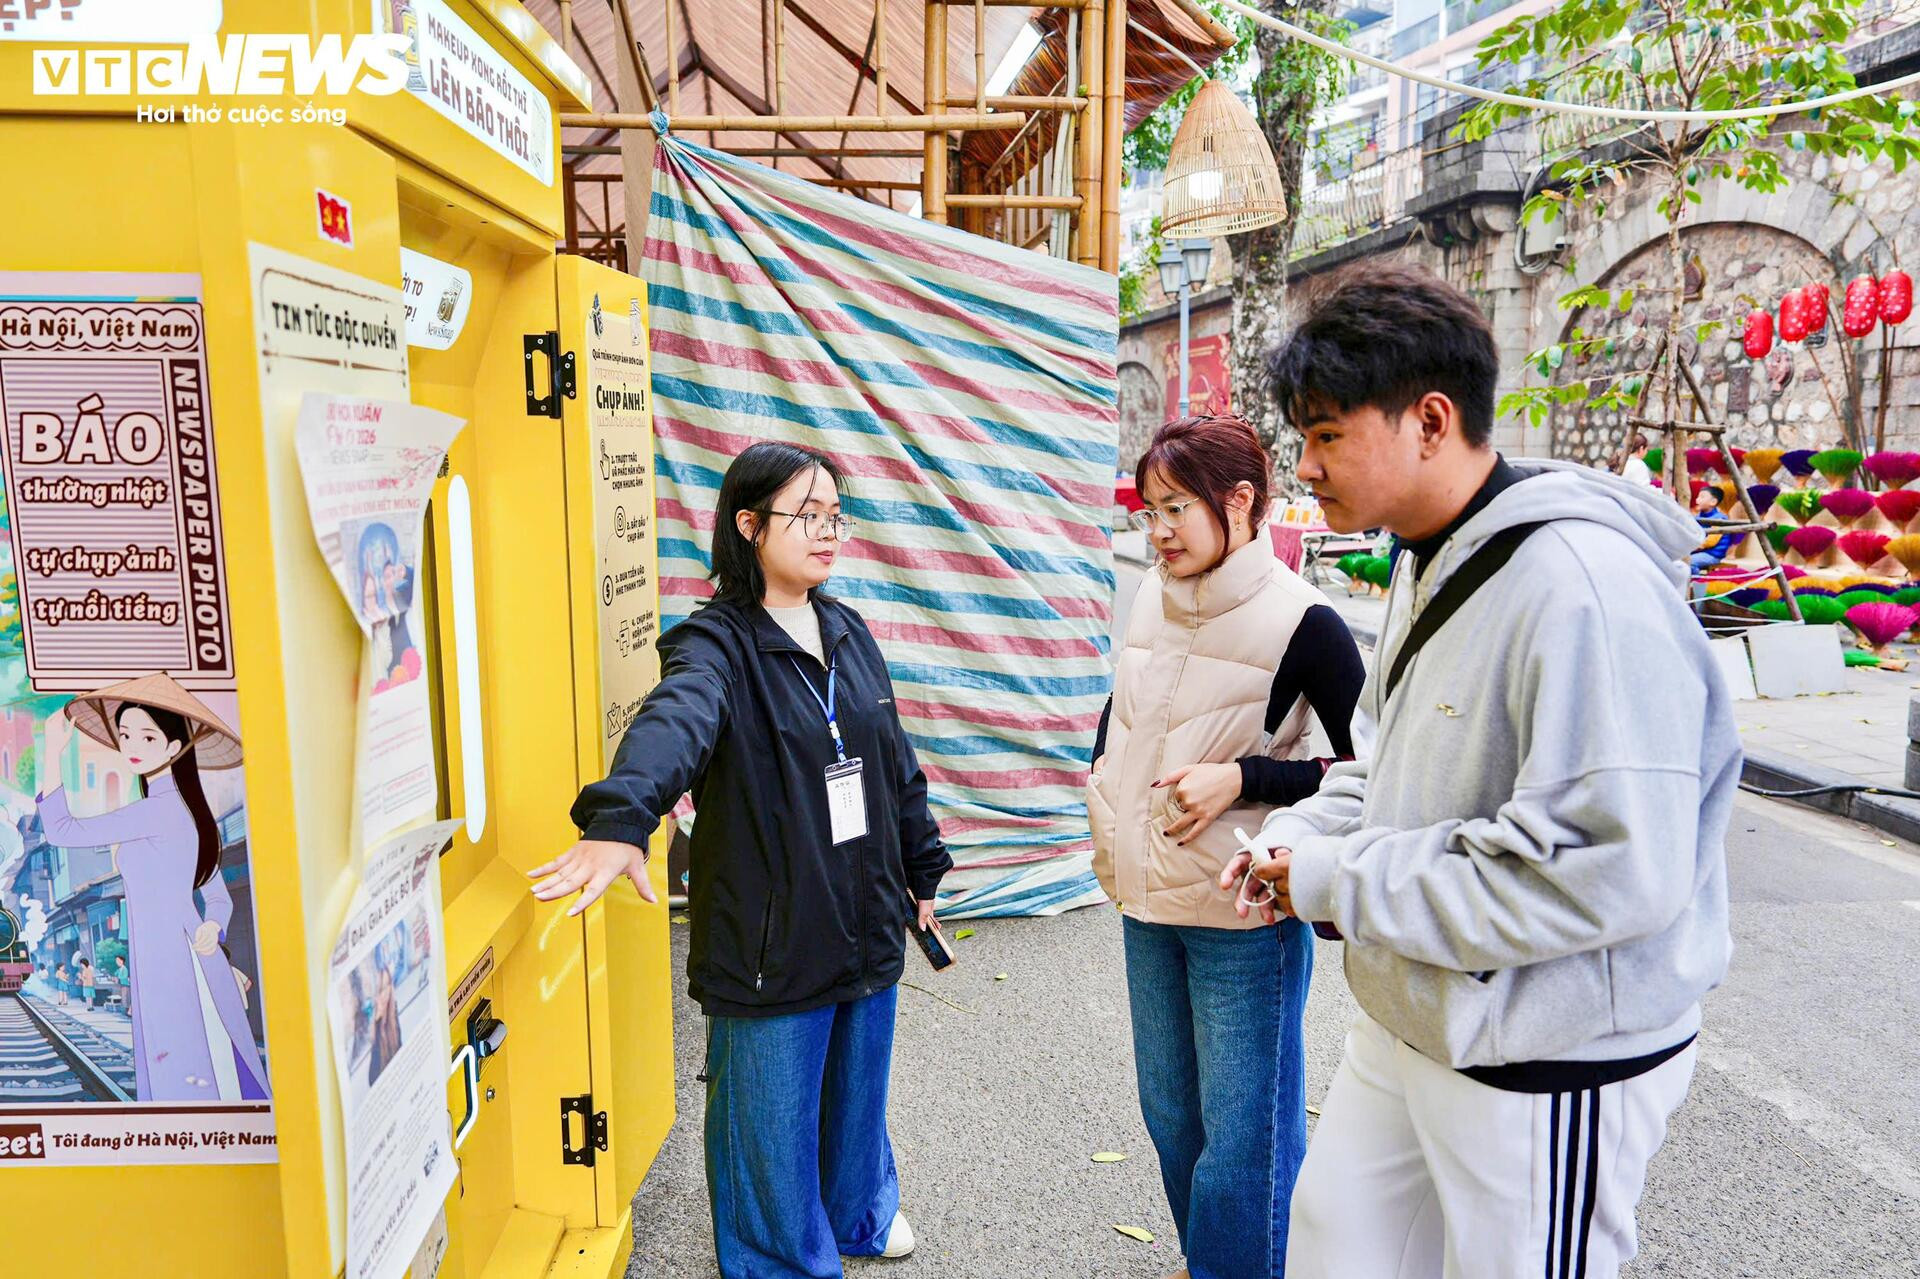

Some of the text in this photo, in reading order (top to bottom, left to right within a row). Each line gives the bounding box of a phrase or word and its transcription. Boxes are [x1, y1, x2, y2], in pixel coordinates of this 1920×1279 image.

[427, 13, 527, 115] MAKEUP XONG RỒI THÌ
[429, 57, 462, 114] LÊN
[497, 111, 529, 162] THÔI
[411, 279, 424, 297] TO
[1, 316, 193, 342] Hà Nội, Việt Nam
[271, 301, 398, 351] TIN TỨC ĐỘC QUYỀN
[596, 382, 645, 417] CHỤP ẢNH!
[19, 392, 165, 466] BÁO
[20, 475, 169, 509] thường nhật
[172, 364, 223, 664] NEWSPAPER PHOTO
[27, 544, 176, 577] tự chụp ảnh
[34, 588, 179, 627] tự nổi tiếng
[53, 1132, 78, 1148] Tôi
[81, 1132, 121, 1151] đang
[124, 1131, 135, 1147] ở
[137, 1131, 161, 1147] Hà
[165, 1131, 198, 1151] Nội,
[201, 1130, 236, 1150] Việt
[238, 1132, 277, 1146] Nam
